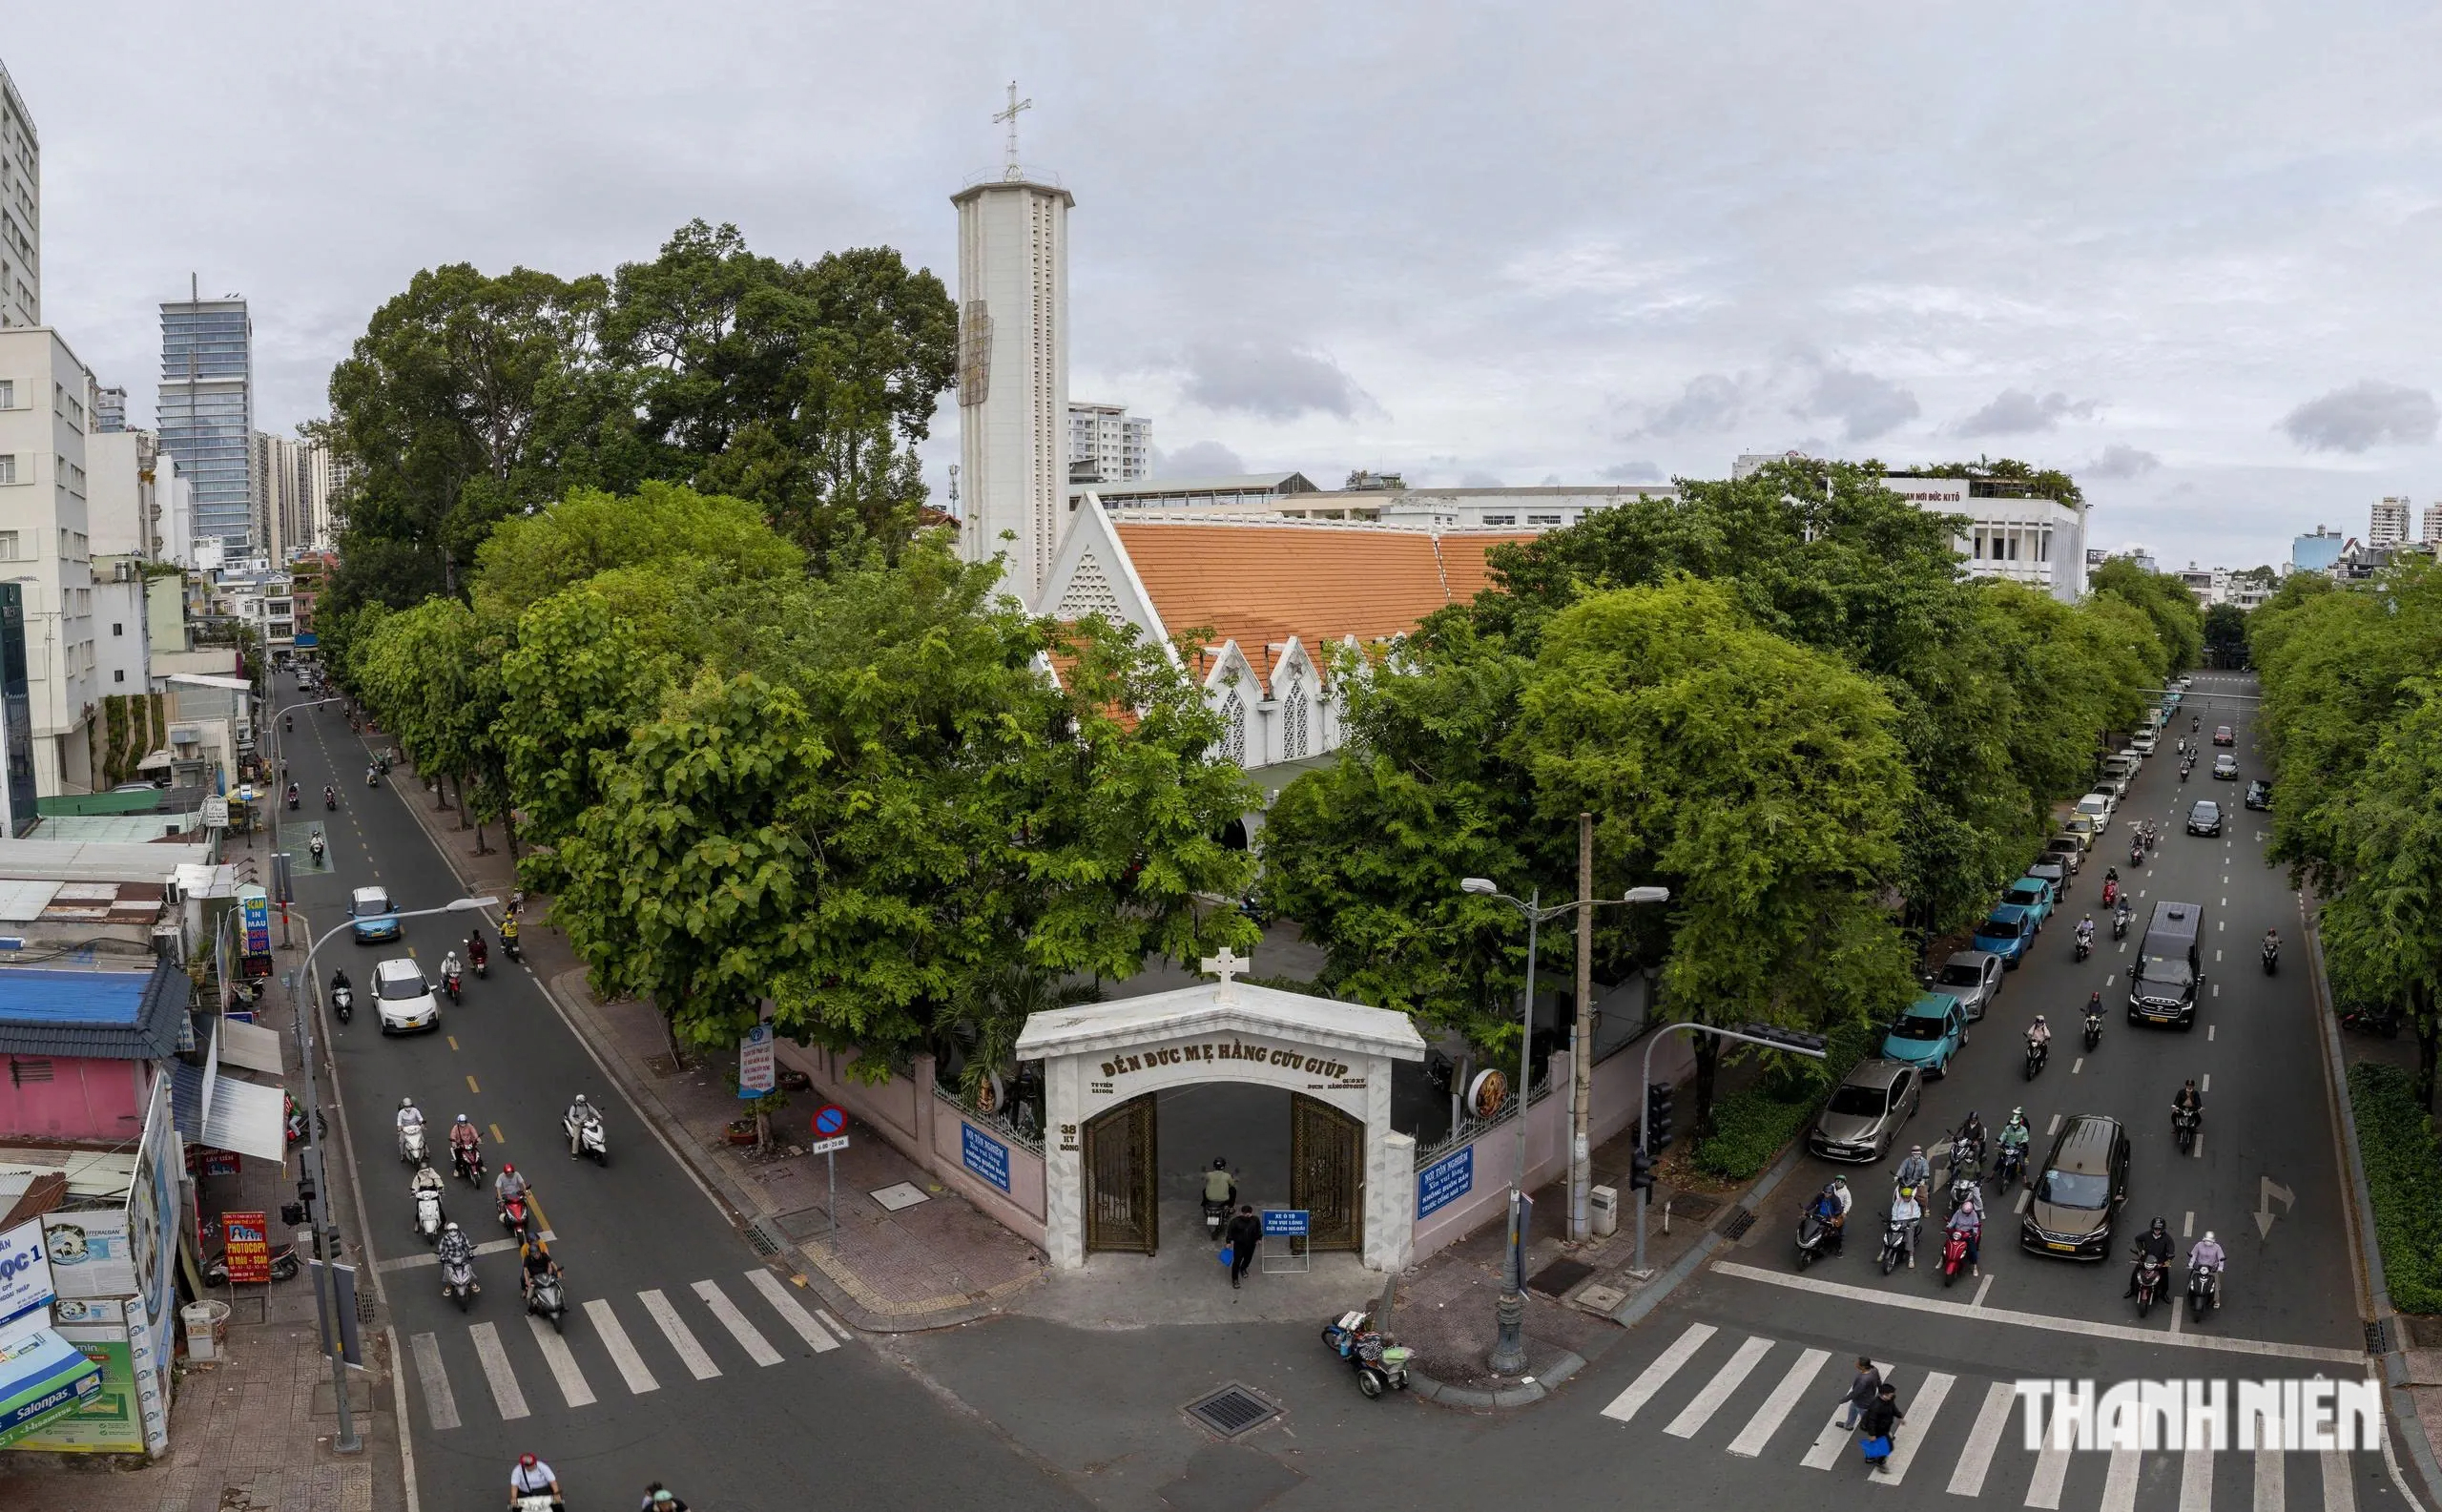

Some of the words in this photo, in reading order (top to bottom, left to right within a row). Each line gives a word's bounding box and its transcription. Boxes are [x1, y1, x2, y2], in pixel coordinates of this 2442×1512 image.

[1101, 1054, 1142, 1078] ĐỀN
[1144, 1047, 1181, 1068] ĐỨC
[1184, 1044, 1214, 1065] MẸ
[1218, 1038, 1268, 1063] HẰNG
[1270, 1049, 1305, 1070] CỨU
[1304, 1058, 1349, 1080] GIÚP
[1061, 1124, 1077, 1135] 38
[0, 1253, 30, 1281] ỌC
[31, 1244, 42, 1262] 1
[227, 1242, 266, 1253] PHOTOCOPY
[16, 1388, 69, 1420] Salonpas
